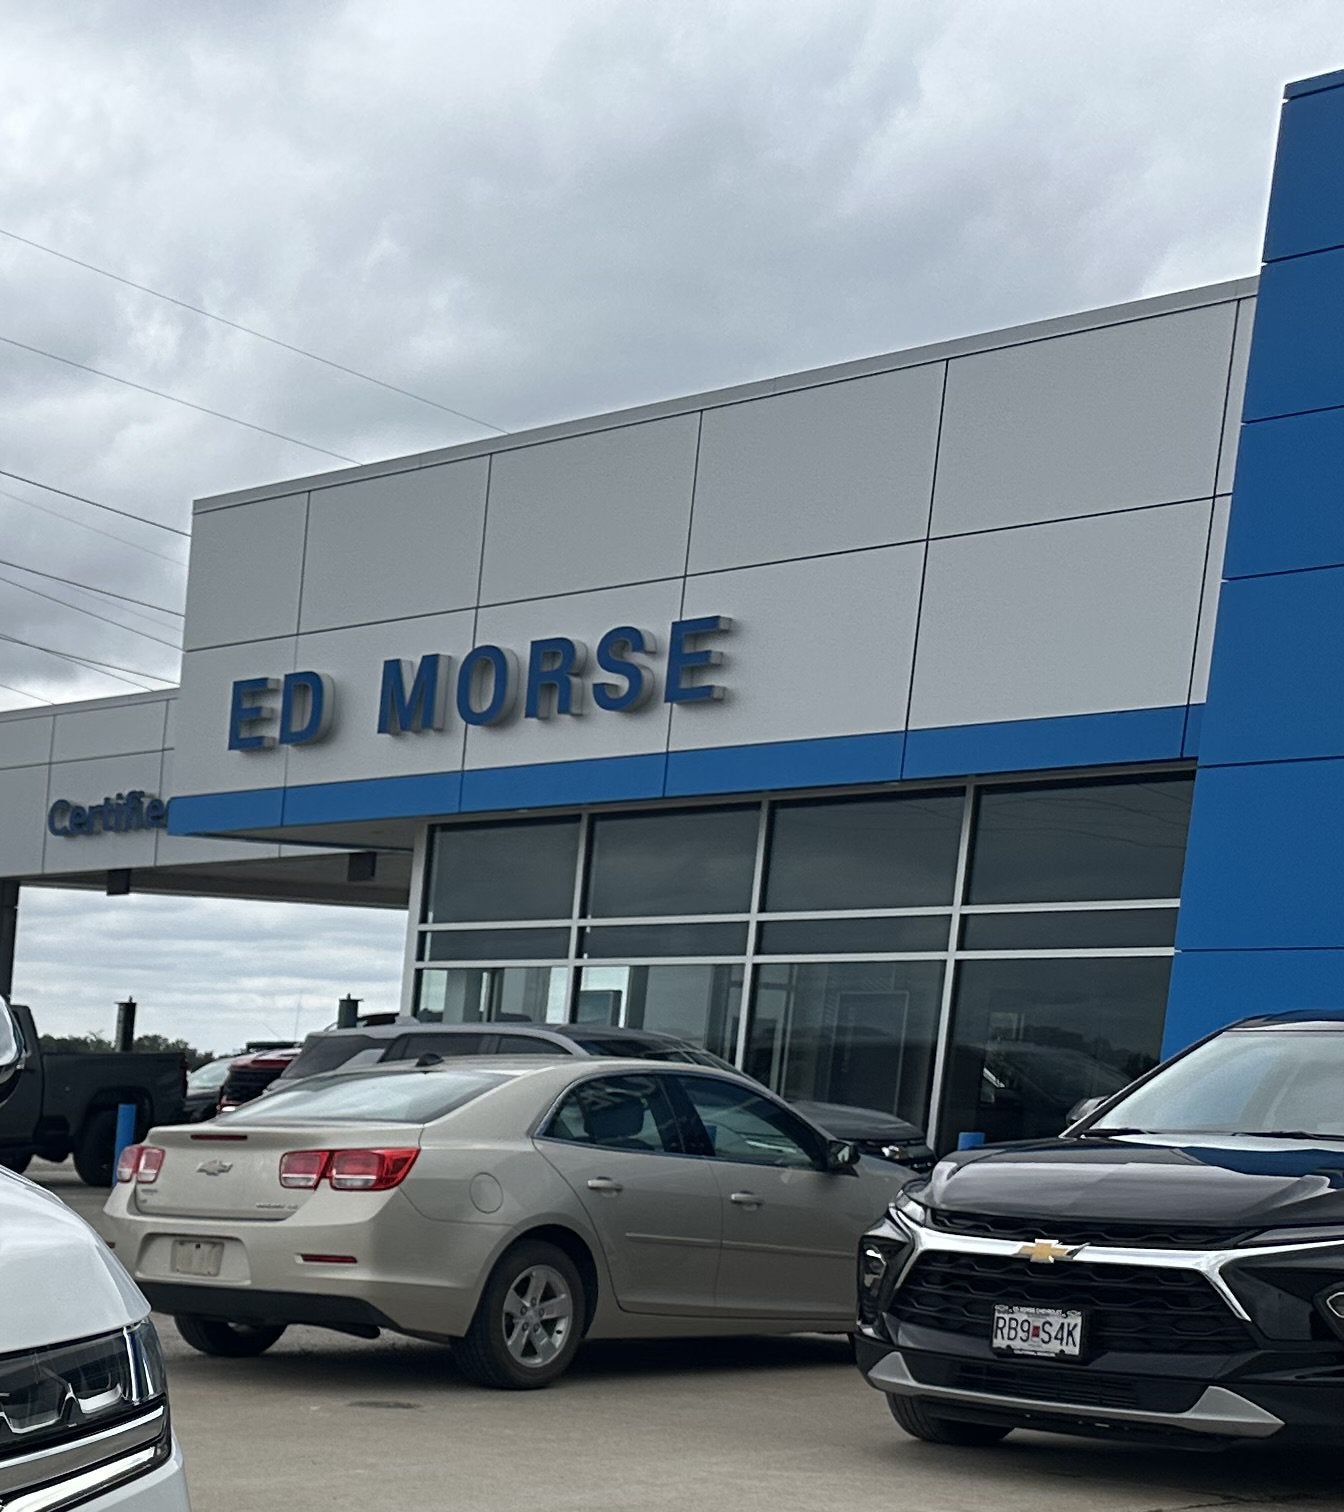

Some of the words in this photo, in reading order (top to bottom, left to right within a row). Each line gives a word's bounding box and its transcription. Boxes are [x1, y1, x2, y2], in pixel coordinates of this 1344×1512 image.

[228, 669, 334, 753] ED
[377, 615, 732, 737] MORSE
[48, 790, 169, 837] Certifie
